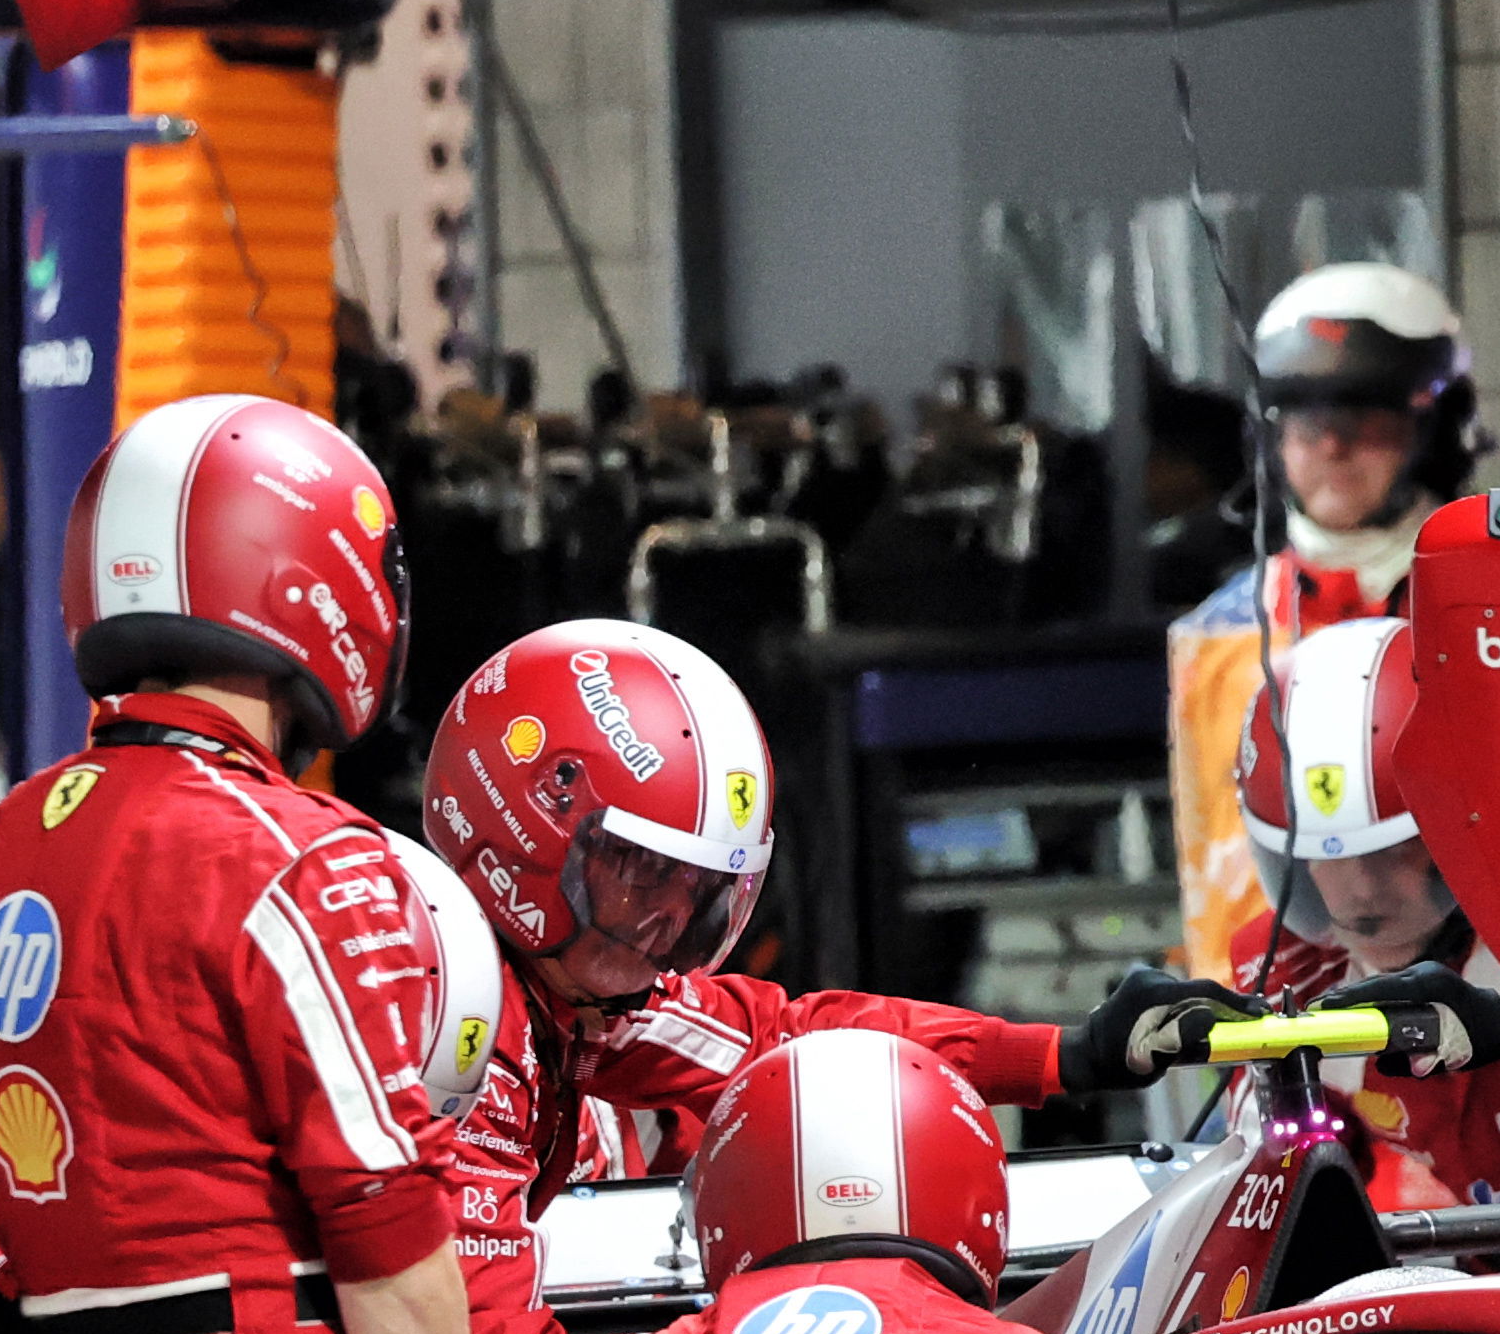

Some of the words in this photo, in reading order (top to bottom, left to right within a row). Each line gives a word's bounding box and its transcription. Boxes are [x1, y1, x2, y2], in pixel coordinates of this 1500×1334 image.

[112, 561, 155, 579] BELL
[581, 671, 664, 780] UniCredit
[467, 748, 505, 811] RICHARD
[500, 804, 538, 855] MILLE
[476, 847, 547, 939] CEVA
[462, 1185, 499, 1224] B&O
[825, 1183, 874, 1199] BELL
[1227, 1173, 1285, 1231] ZCG
[454, 1233, 525, 1261] mbipar
